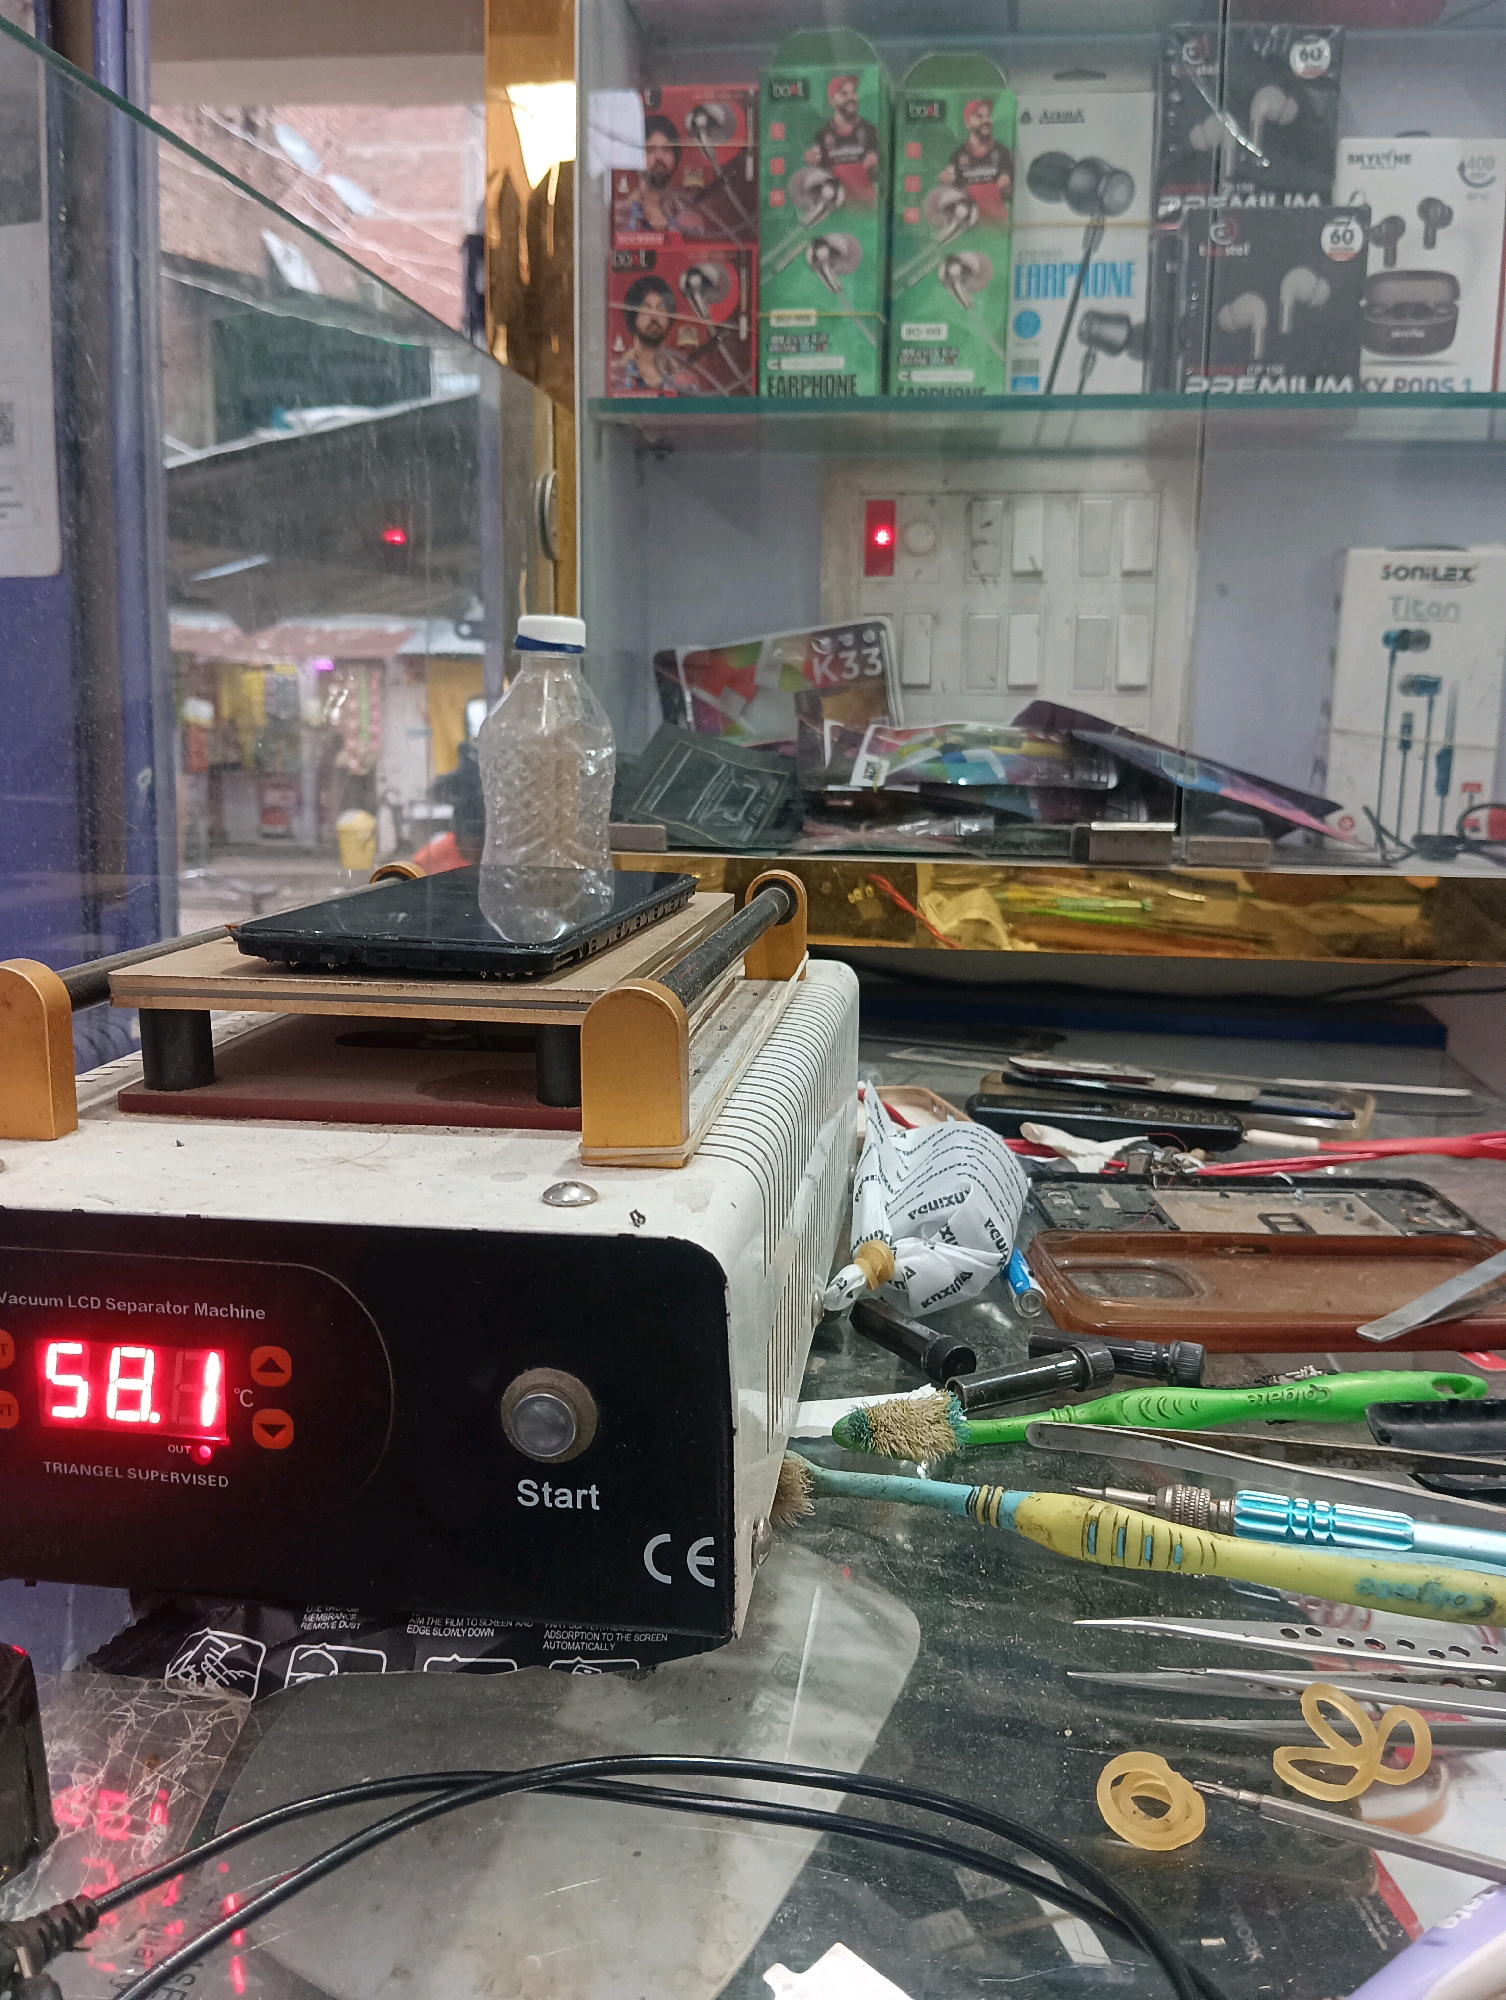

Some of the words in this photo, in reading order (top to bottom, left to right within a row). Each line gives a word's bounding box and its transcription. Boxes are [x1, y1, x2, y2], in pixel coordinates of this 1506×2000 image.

[1329, 229, 1354, 245] 60
[812, 648, 883, 684] K33
[67, 1295, 101, 1310] LCD
[105, 1297, 190, 1315] Separator
[194, 1302, 266, 1320] Machine
[45, 1342, 221, 1428] 58.1
[1246, 1383, 1332, 1407] Colgate
[167, 1444, 192, 1454] OUT
[43, 1461, 124, 1479] TRIANGEL
[127, 1467, 229, 1488] SUPERVISED
[517, 1478, 600, 1511] Start
[300, 1621, 337, 1631] REMOVE
[338, 1620, 362, 1630] DUST
[426, 1617, 442, 1627] THE
[444, 1617, 464, 1627] FILM
[466, 1618, 478, 1627] TO
[406, 1624, 431, 1636] EDGE
[467, 1628, 495, 1638] DOWN
[543, 1630, 600, 1641] ADSORPTION
[601, 1632, 614, 1642] TO
[616, 1632, 632, 1642] THE
[633, 1633, 669, 1642] SCREEN
[542, 1641, 617, 1651] AUTOMATICALLY
